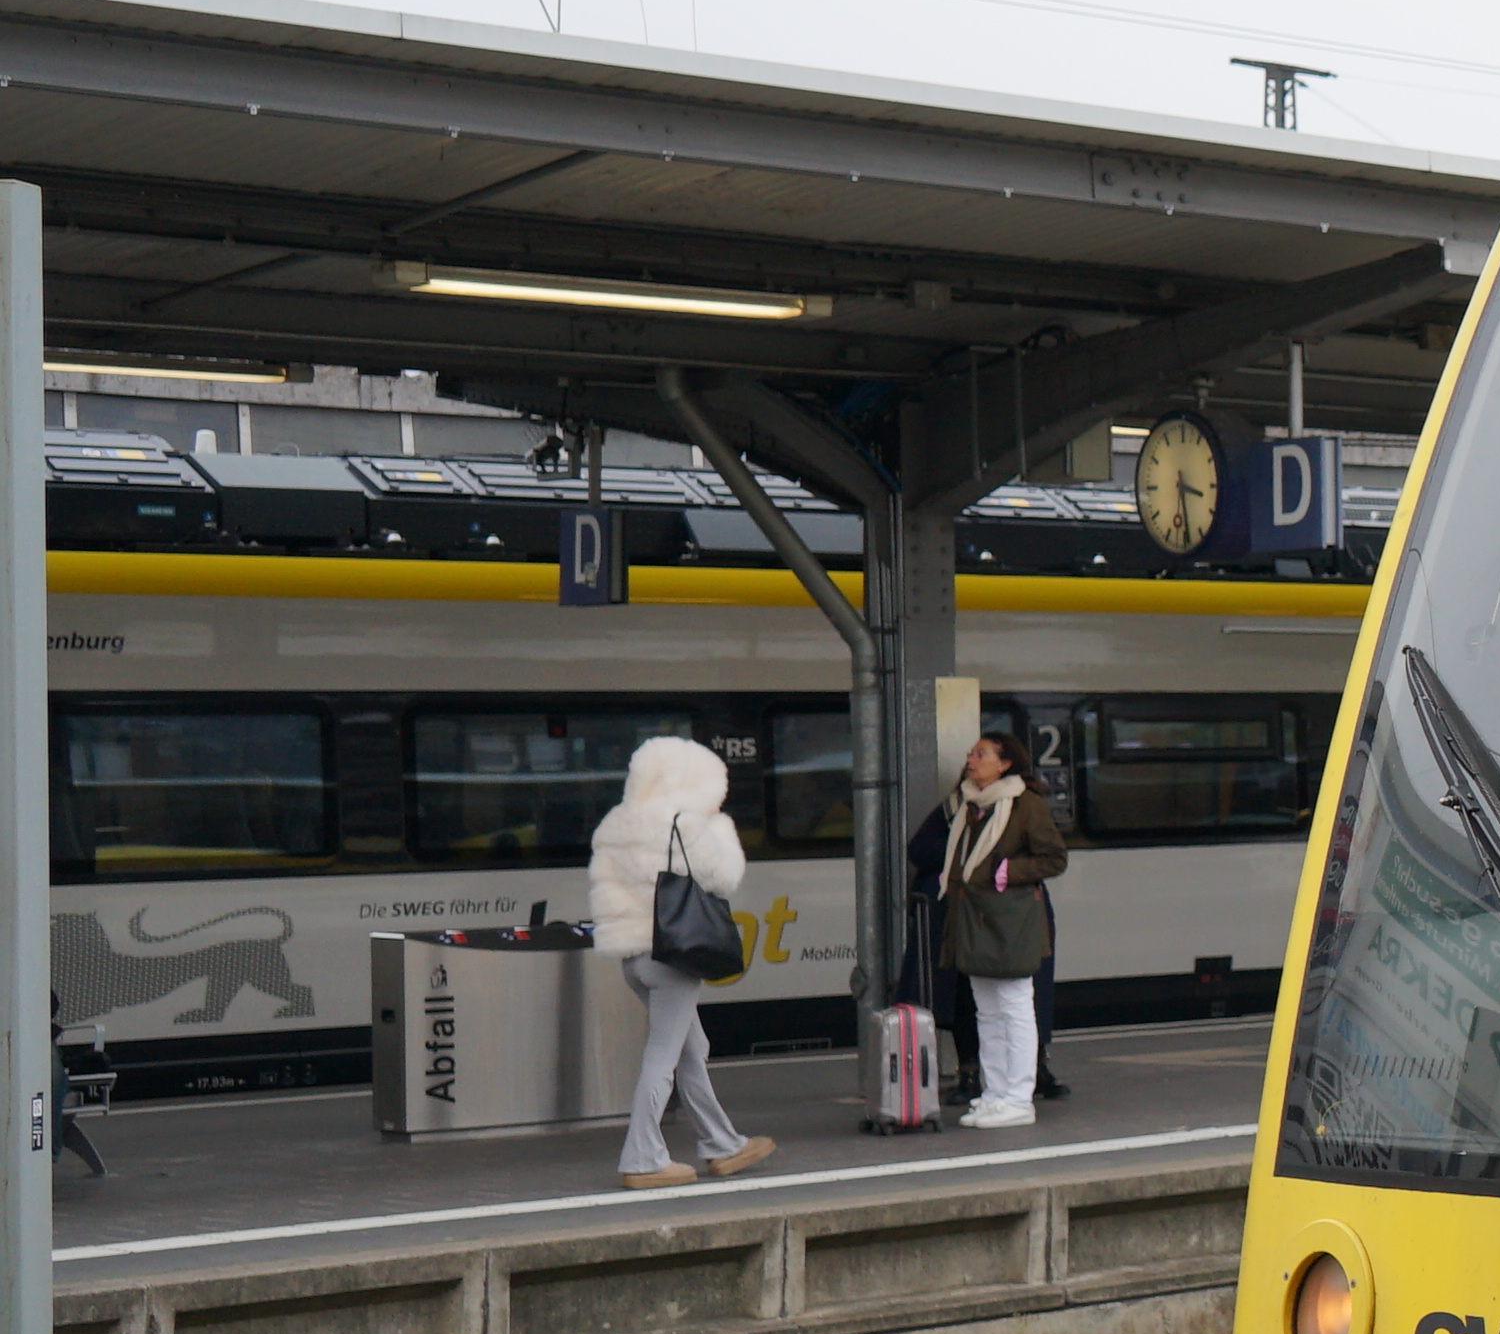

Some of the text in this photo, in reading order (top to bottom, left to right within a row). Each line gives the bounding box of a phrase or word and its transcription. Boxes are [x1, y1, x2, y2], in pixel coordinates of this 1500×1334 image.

[1272, 443, 1313, 528] D
[574, 514, 602, 584] D
[46, 632, 125, 654] enburg
[1038, 724, 1062, 767] 2
[359, 896, 518, 919] Die SWEG fährt für
[424, 995, 457, 1104] Abfall
